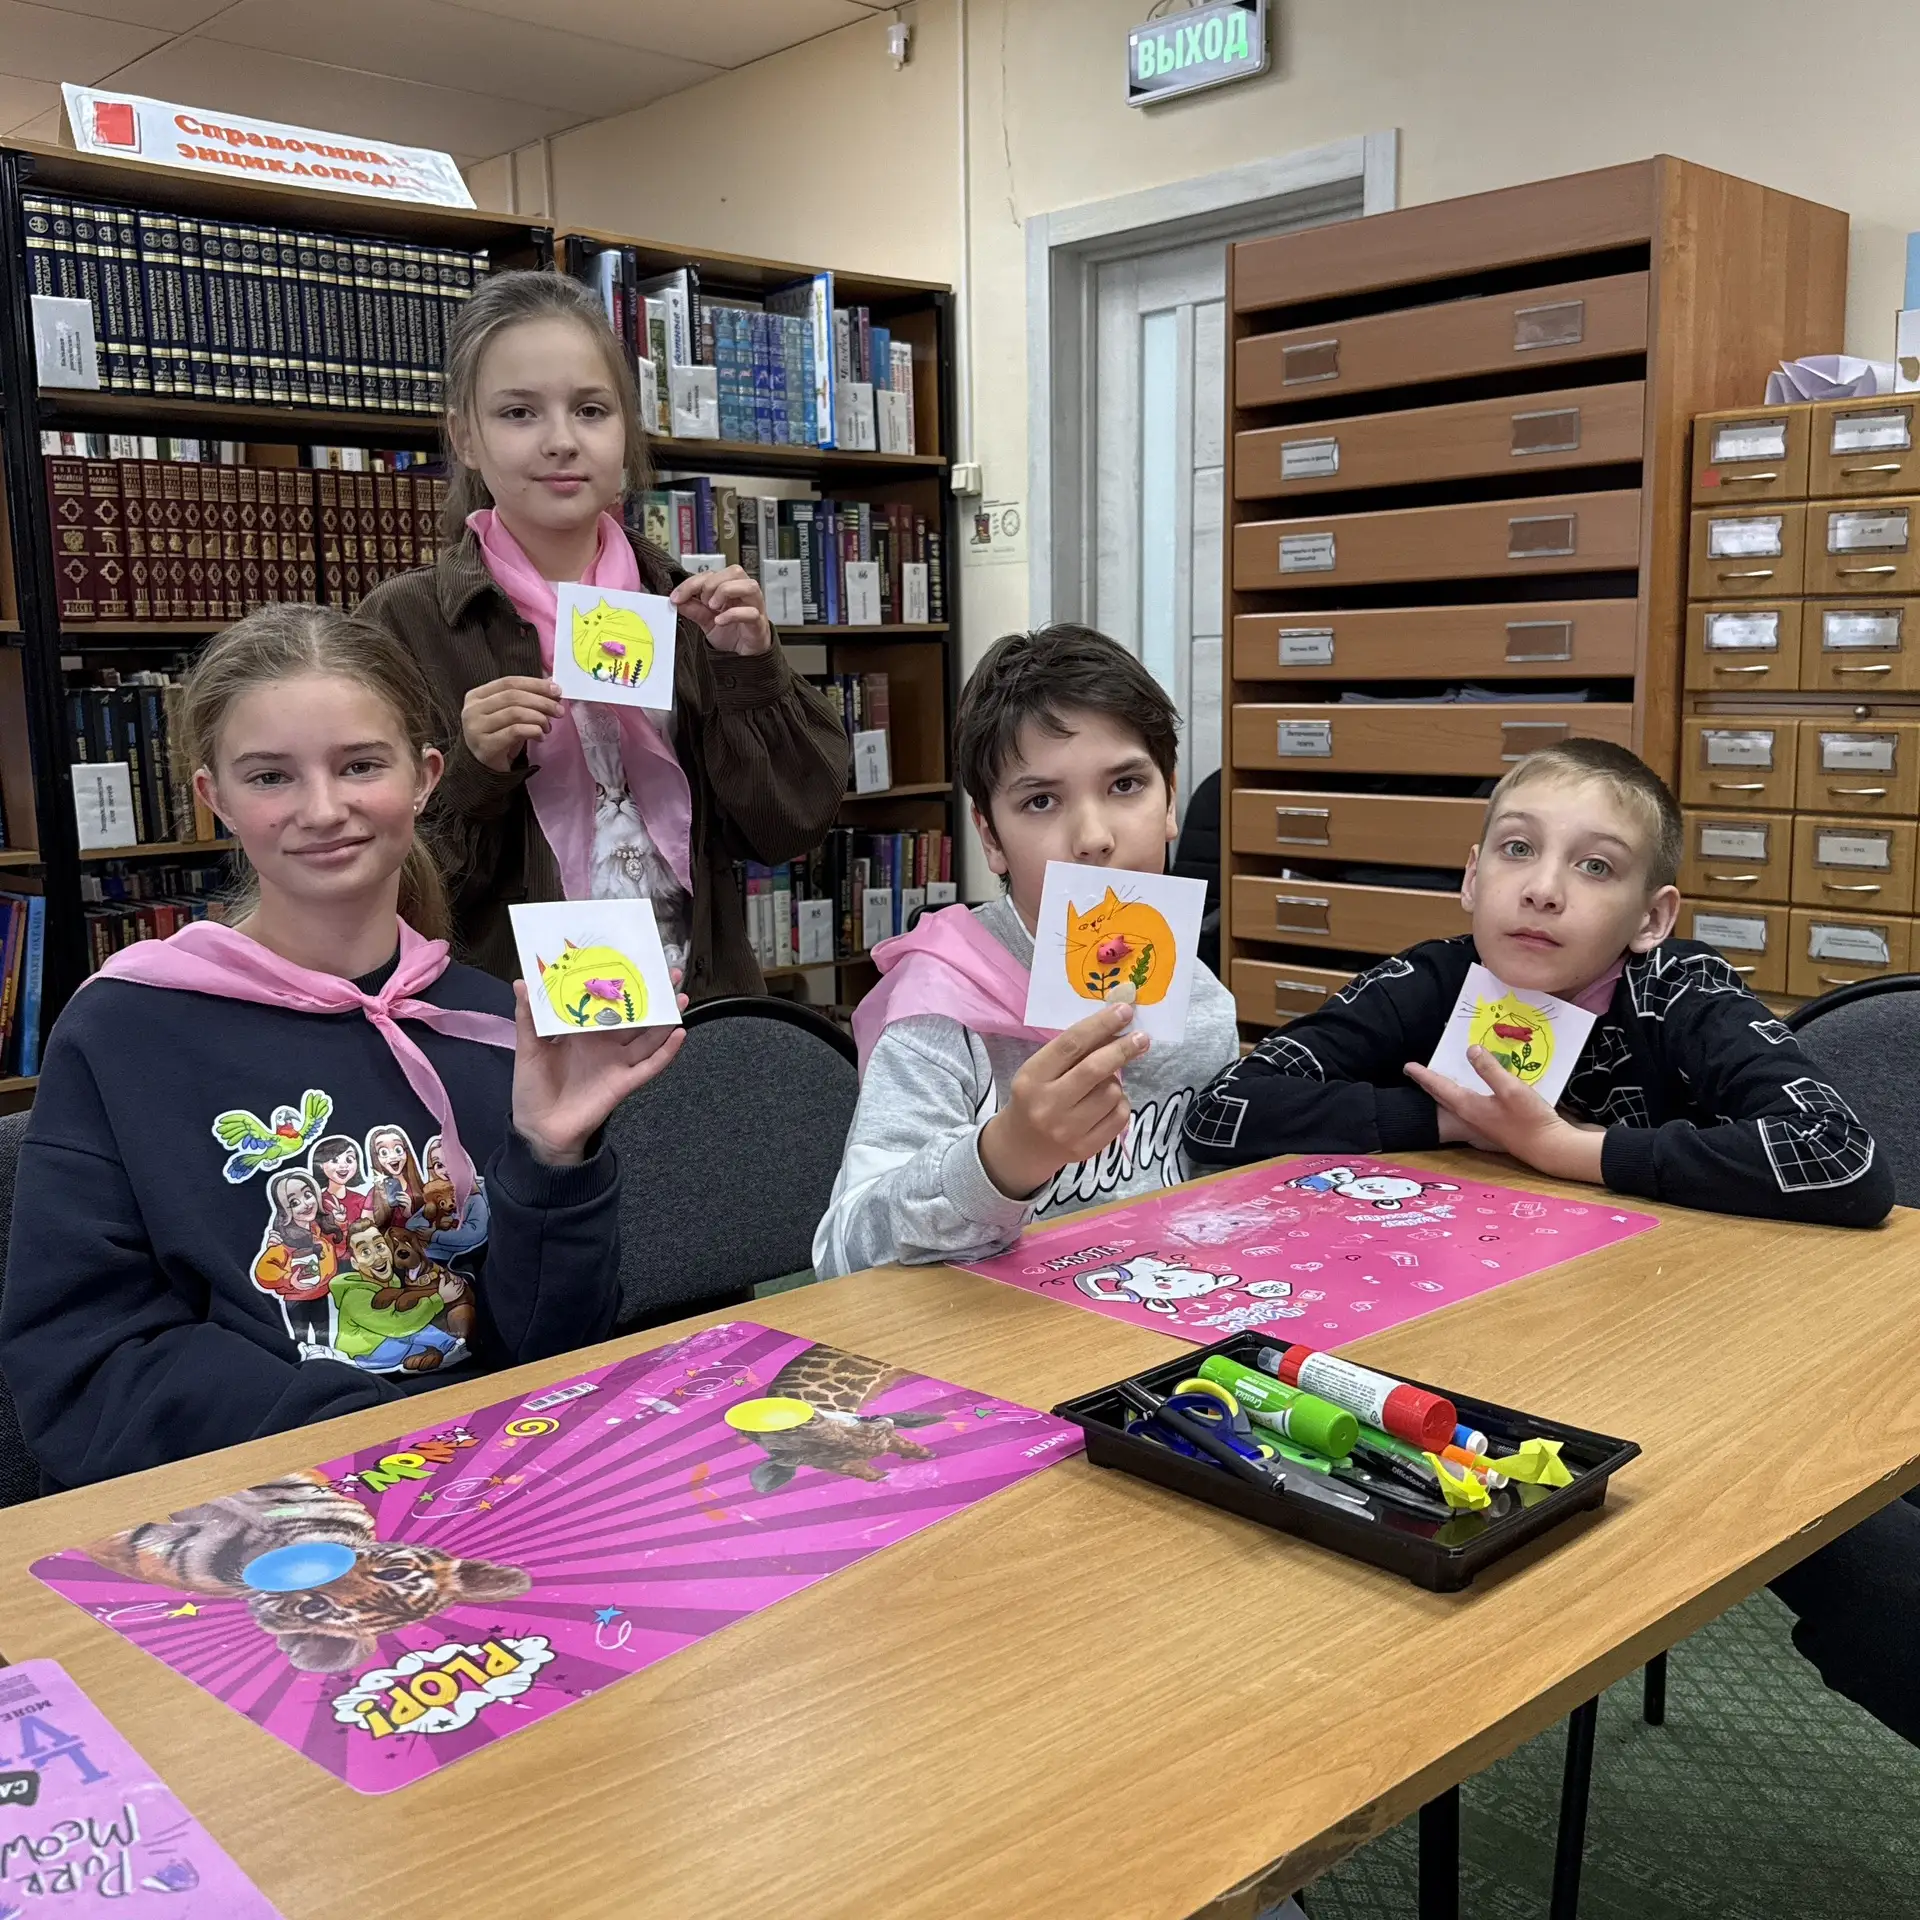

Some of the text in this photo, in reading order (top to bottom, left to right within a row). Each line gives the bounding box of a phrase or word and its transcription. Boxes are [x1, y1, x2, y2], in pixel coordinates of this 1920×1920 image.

[1137, 10, 1248, 80] ВЫХОД
[173, 114, 408, 168] Справочник
[118, 357, 125, 366] 3
[138, 358, 146, 367] 4
[160, 360, 167, 369] 5
[179, 360, 186, 370] 6
[200, 364, 206, 373] 7
[220, 364, 227, 375] 8
[239, 367, 247, 376] 9
[256, 368, 268, 378] 10
[275, 369, 286, 379] 11
[294, 371, 305, 381] 12
[312, 372, 324, 382] 13
[332, 375, 342, 384] 14
[349, 376, 360, 385] 24
[382, 379, 393, 388] 26
[400, 380, 410, 388] 27
[852, 392, 857, 403] 3
[797, 522, 813, 603] ЭКОНОМИЧЕСКИЙ
[778, 567, 788, 577] 65
[858, 569, 868, 579] 66
[1234, 1388, 1262, 1409] Crostick
[358, 1438, 482, 1493] WOW
[1390, 1465, 1427, 1491] OfficeSpace
[355, 1636, 523, 1739] PLOP!
[0, 1778, 29, 1798] CA
